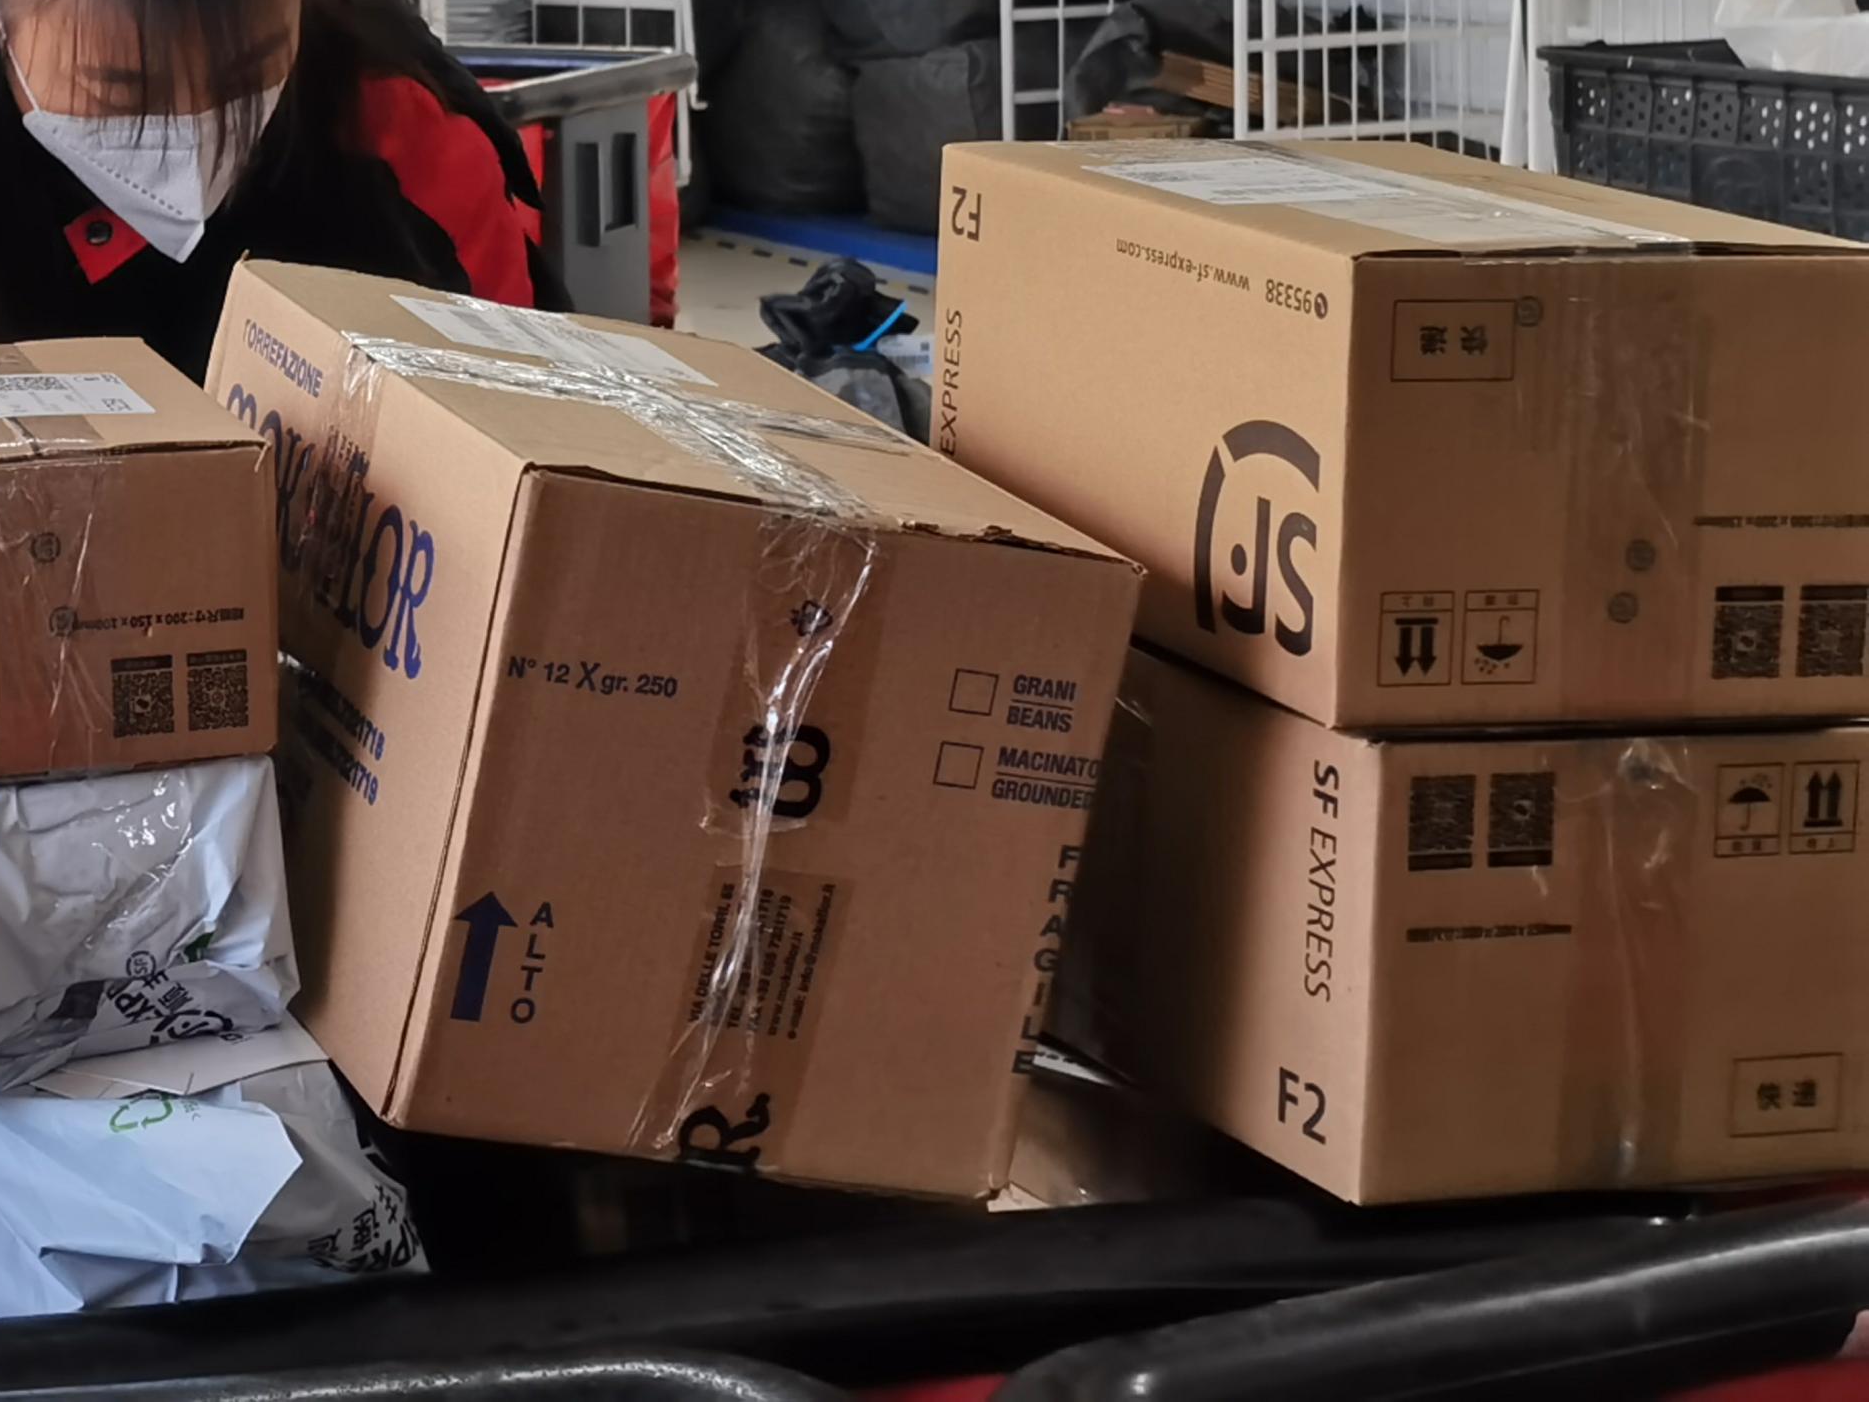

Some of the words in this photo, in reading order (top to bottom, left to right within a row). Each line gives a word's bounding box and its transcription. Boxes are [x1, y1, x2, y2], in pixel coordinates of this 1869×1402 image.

[951, 186, 981, 242] F2
[1116, 237, 1251, 291] www.sf-express.com
[1265, 278, 1313, 314] 95338
[242, 318, 324, 398] TORREFAZIONE
[940, 308, 963, 456] EXPRESS
[545, 663, 570, 684] 12
[577, 659, 600, 688] X
[603, 674, 630, 696] gr.
[636, 675, 678, 698] 250
[1013, 674, 1076, 702] GRANI
[1006, 705, 1073, 733] BEANS
[997, 747, 1101, 780] MACINATO
[1313, 760, 1339, 819] SF
[1304, 828, 1337, 1003] EXPRESS
[510, 901, 554, 1024] ALTO
[1012, 845, 1081, 1074] FRAGILE
[1277, 1067, 1328, 1144] F2
